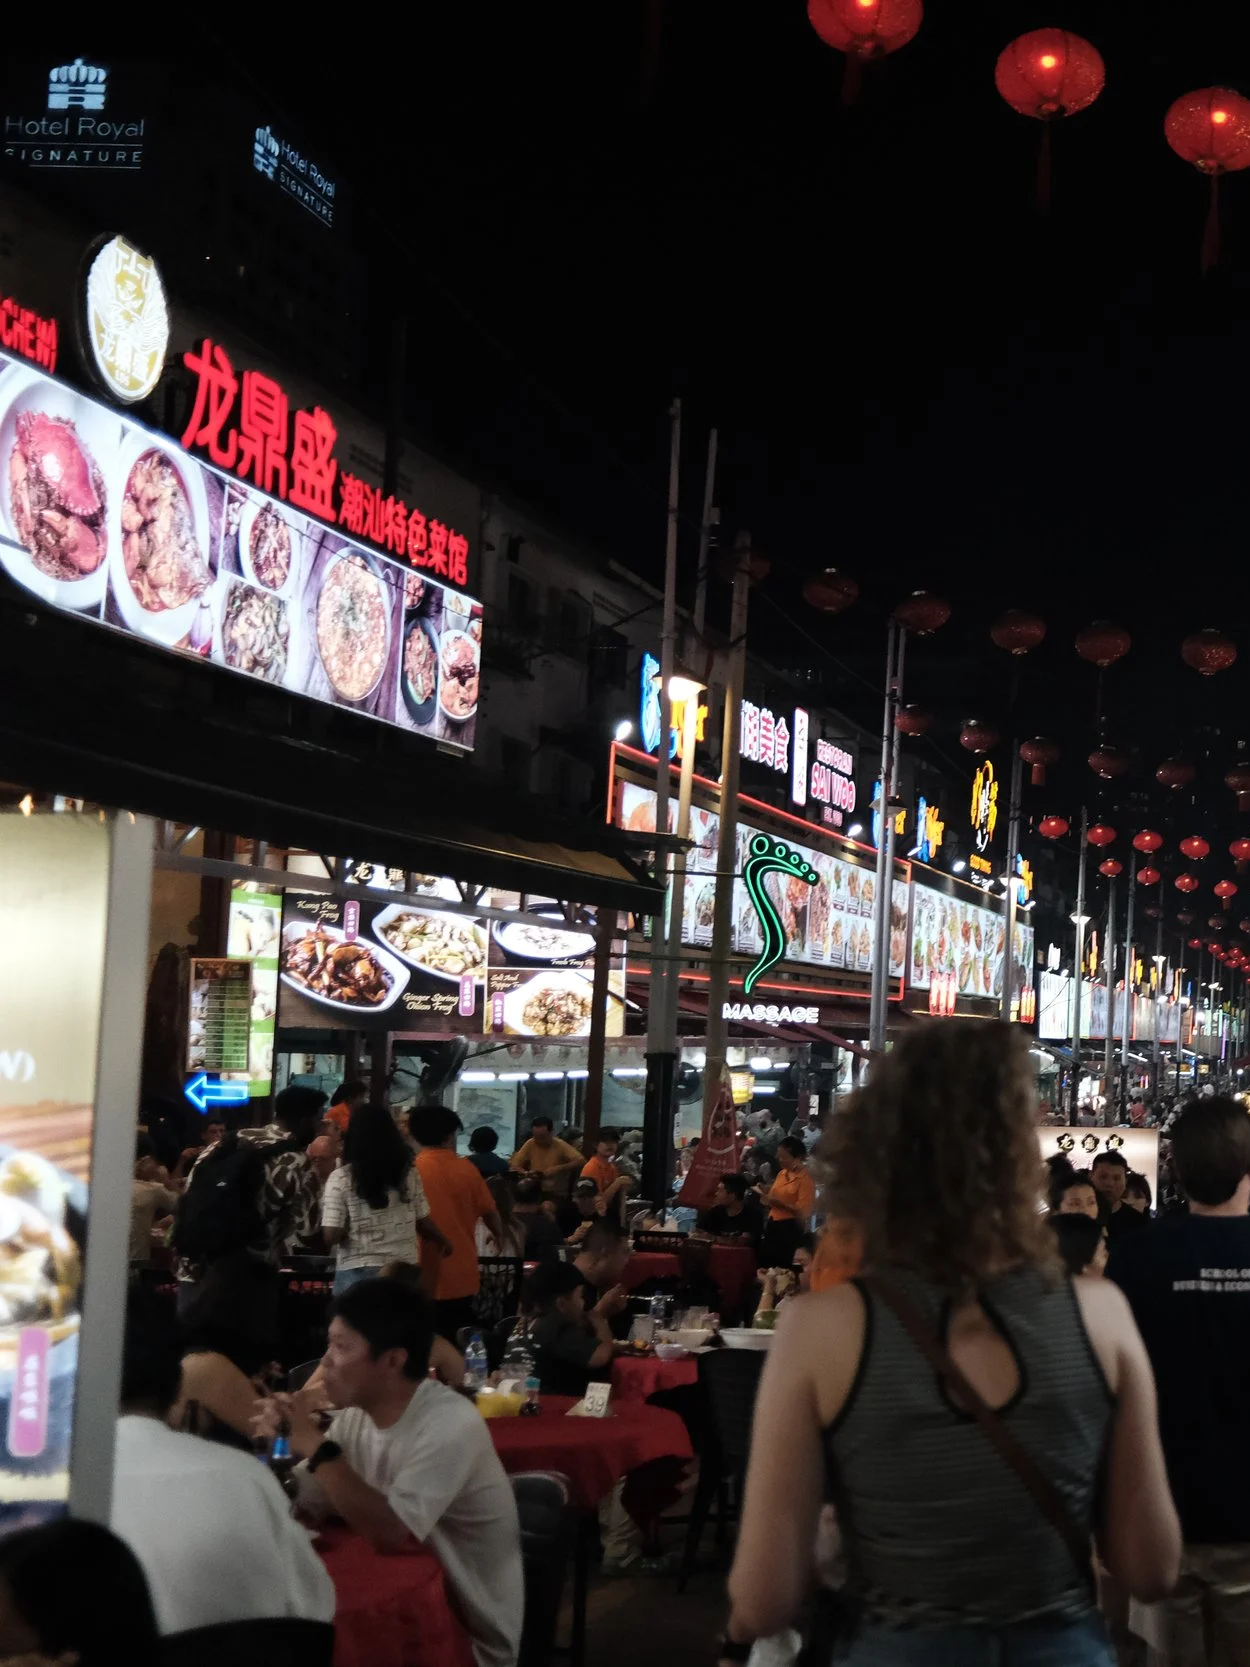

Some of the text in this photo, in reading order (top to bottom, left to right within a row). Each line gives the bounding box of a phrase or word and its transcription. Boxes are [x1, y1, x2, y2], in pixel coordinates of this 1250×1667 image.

[4, 116, 145, 141] Hotel Royal
[4, 148, 142, 163] SIGNATURE
[281, 139, 335, 199] Hotel Royal
[280, 171, 333, 222] SIGNATURE
[181, 338, 469, 586] 龙鼎盛 潮汕特色菜馆
[811, 762, 856, 813] SAI WOO
[402, 993, 431, 1004] Ginger
[431, 993, 460, 1005] Spring
[722, 1002, 820, 1024] MASSAGE
